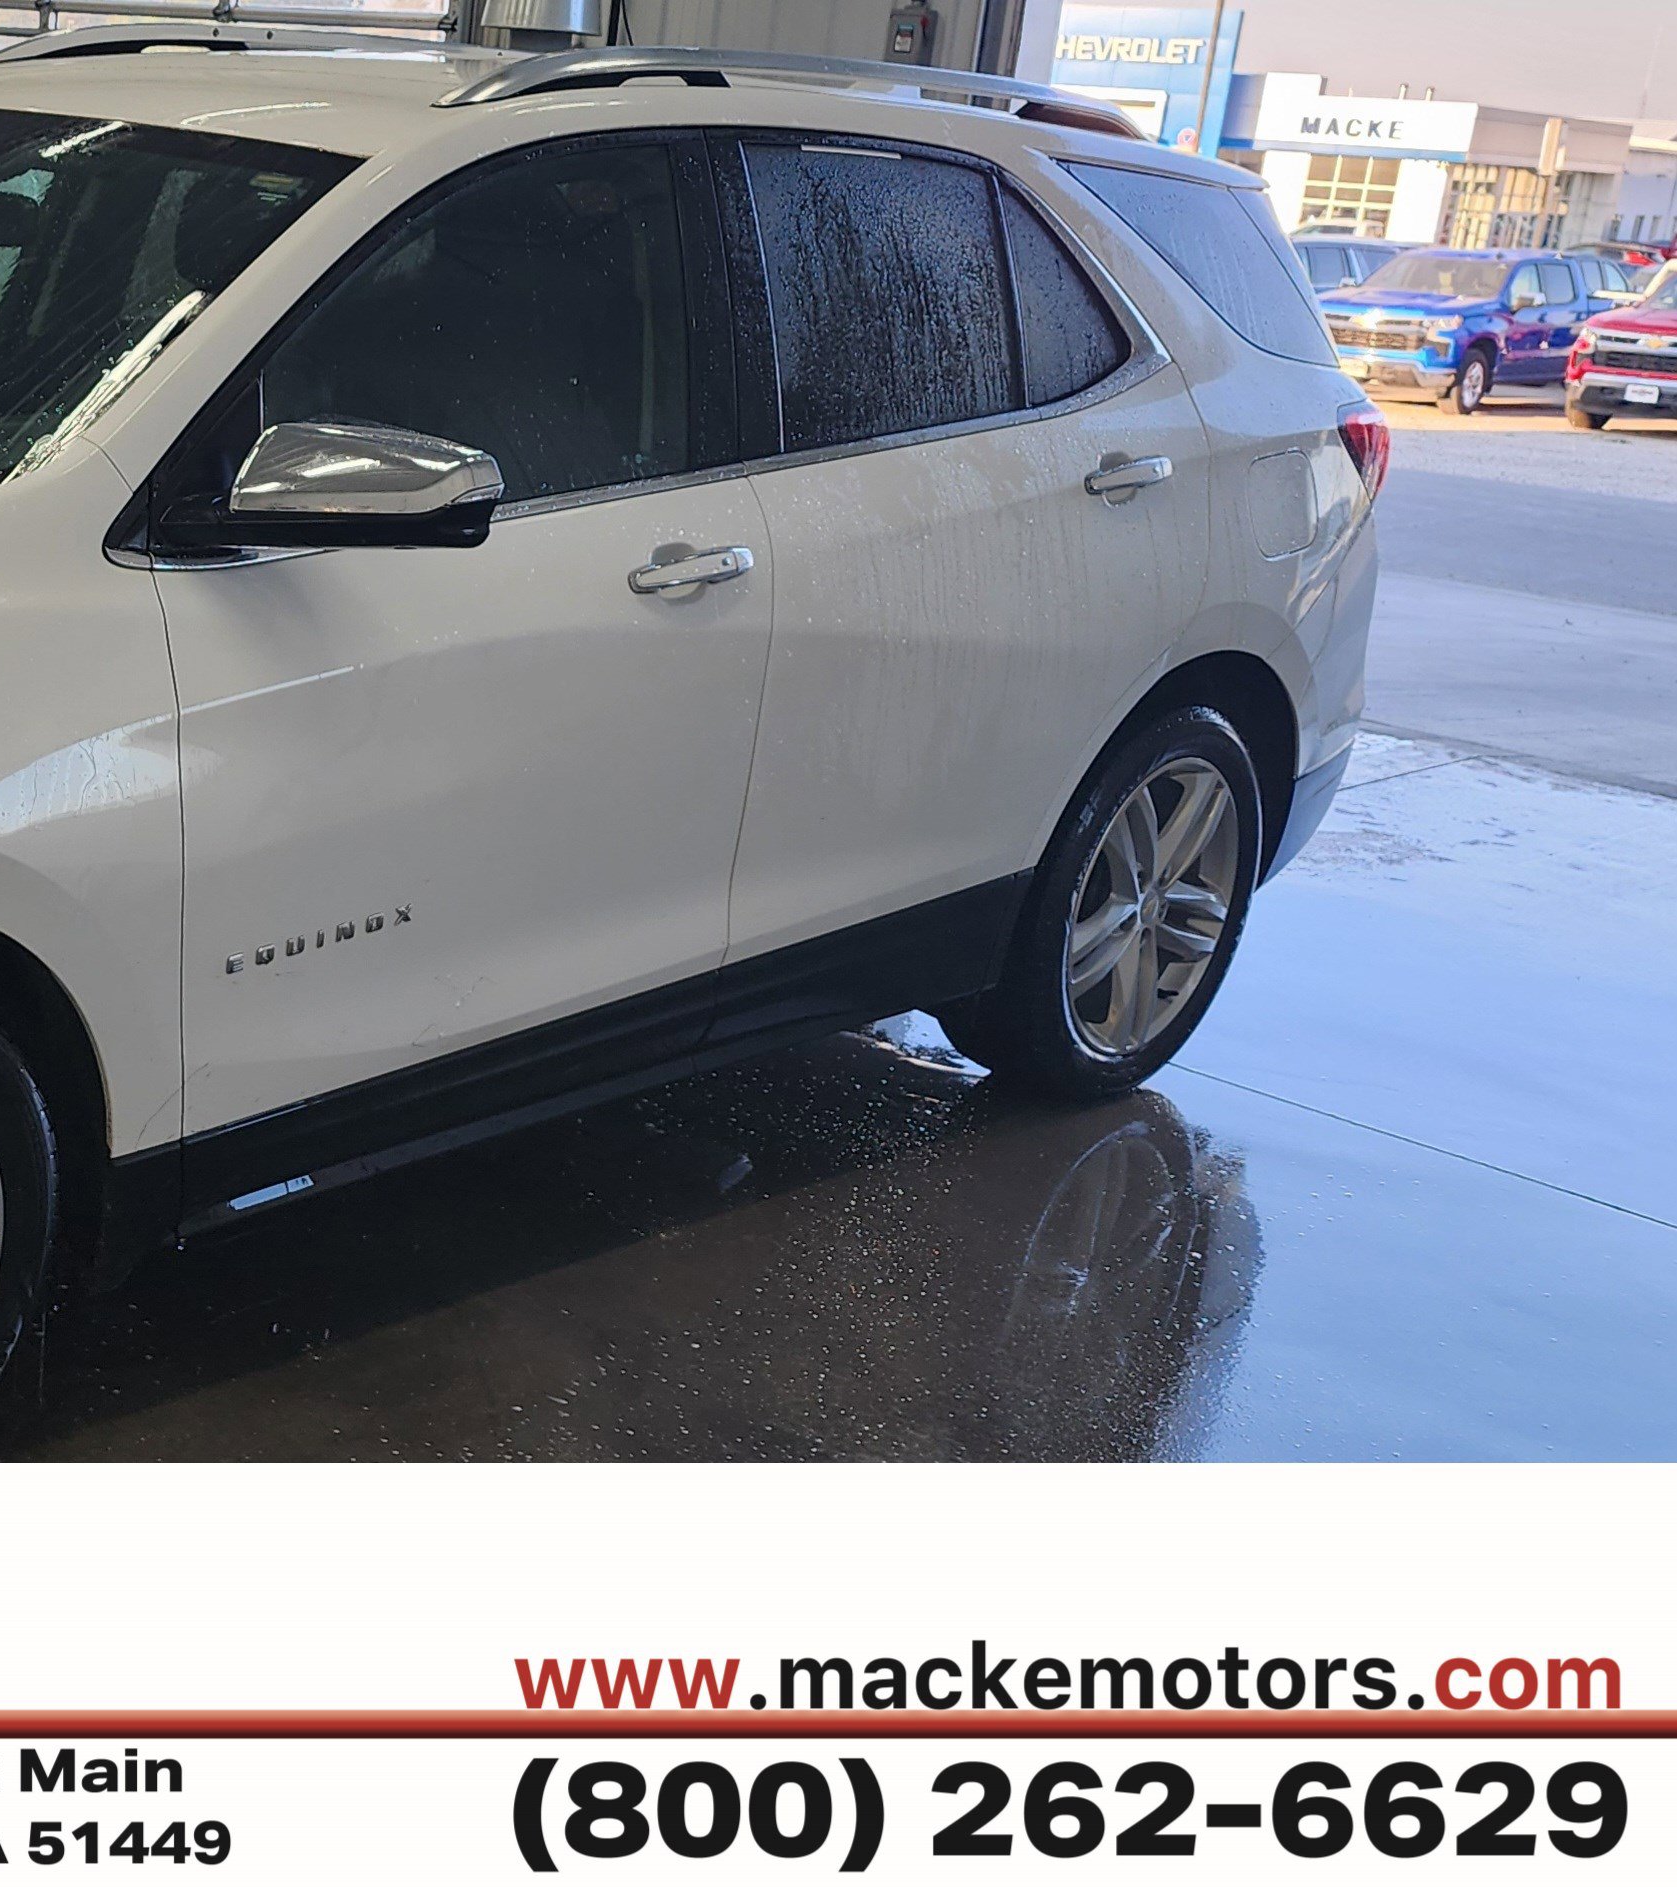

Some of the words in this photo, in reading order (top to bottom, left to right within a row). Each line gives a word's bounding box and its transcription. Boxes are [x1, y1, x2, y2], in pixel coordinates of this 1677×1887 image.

[1055, 34, 1204, 64] HEVROLET
[1300, 116, 1405, 141] MACKE
[226, 903, 412, 974] EQUINOX
